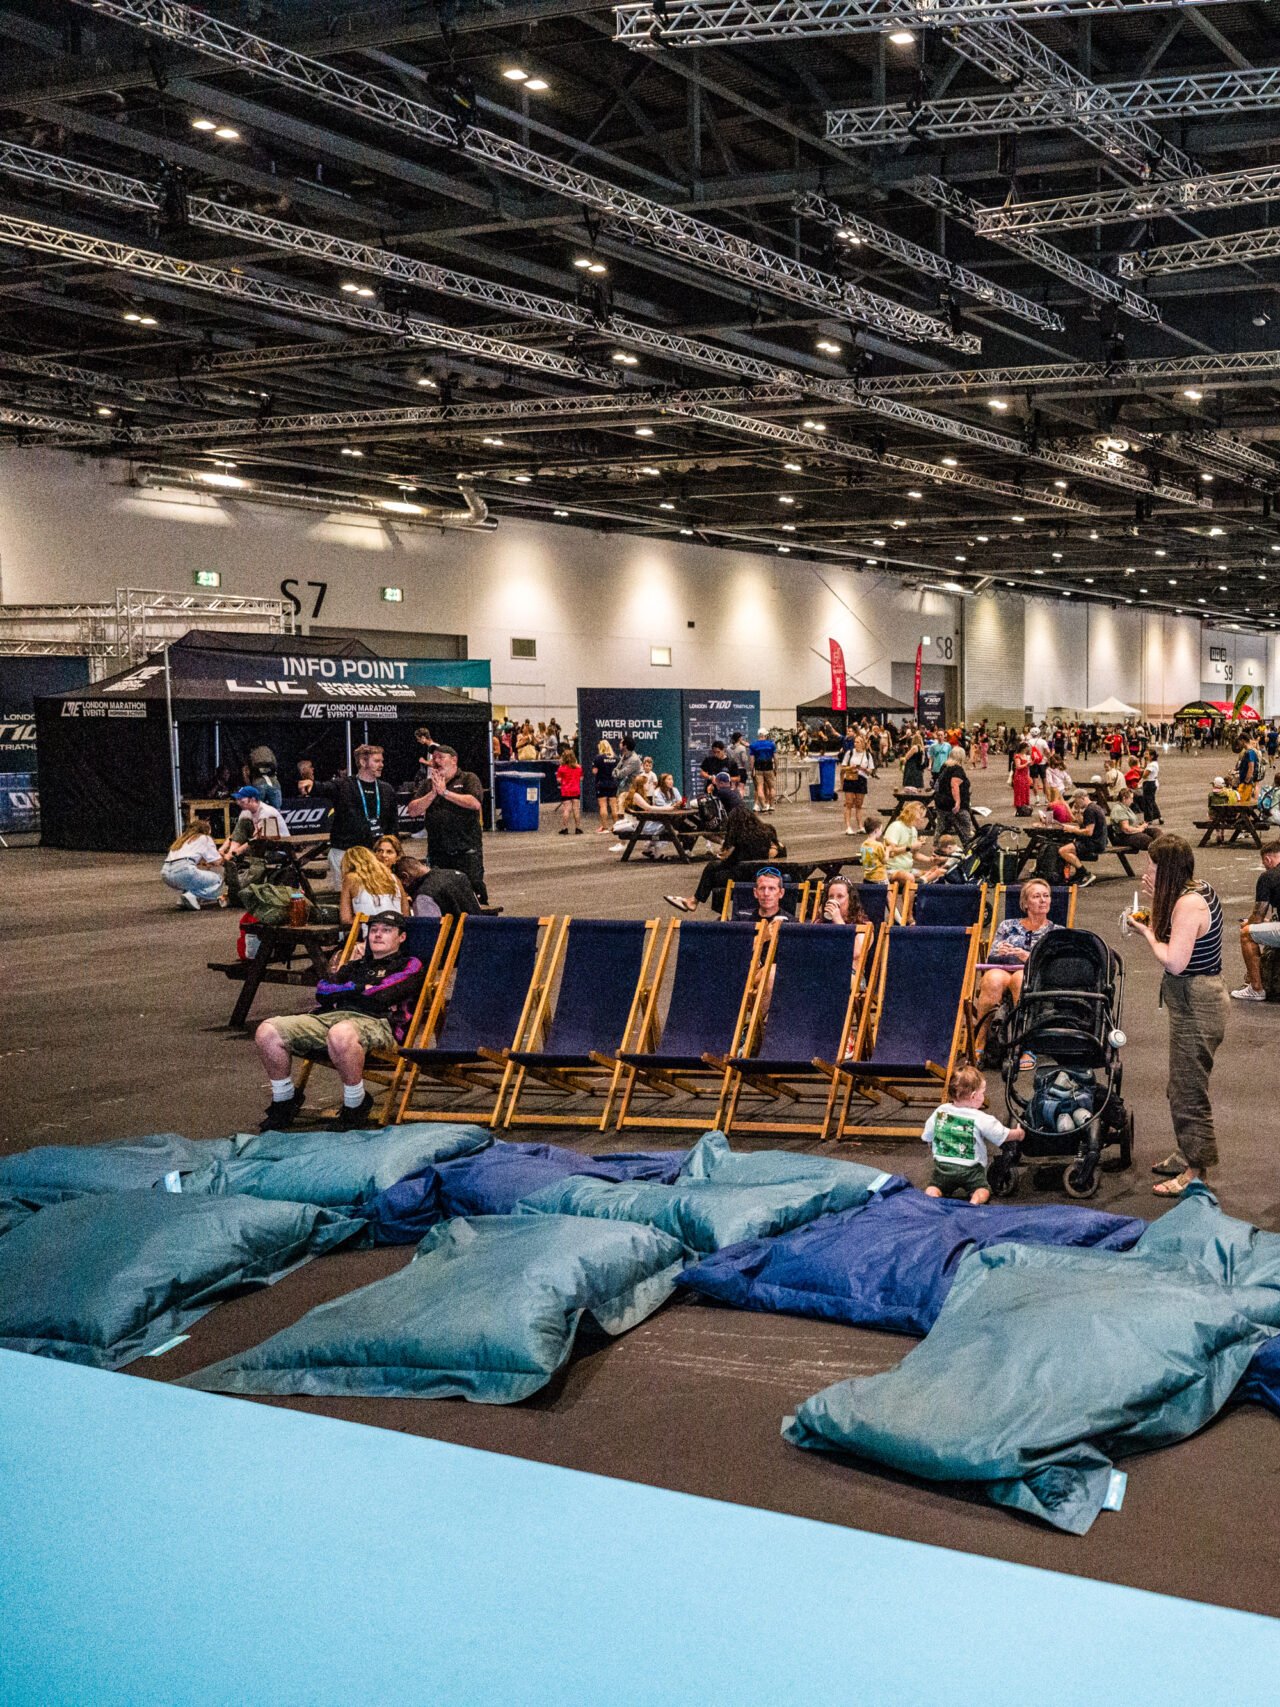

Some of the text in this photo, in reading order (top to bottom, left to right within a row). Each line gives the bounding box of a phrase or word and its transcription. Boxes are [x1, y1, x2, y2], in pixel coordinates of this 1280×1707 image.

[280, 578, 328, 618] S7
[936, 636, 953, 660] S8
[282, 657, 408, 680] INFO POINT
[1225, 665, 1233, 681] S9
[109, 702, 147, 710] MARATHON
[358, 704, 398, 712] MARATHON
[707, 700, 732, 709] T100
[4, 713, 36, 721] LONDO
[83, 709, 105, 717] EVENTS
[595, 719, 663, 728] WATER BOTTLE
[0, 723, 37, 741] T10
[632, 731, 659, 740] POINT
[0, 743, 38, 751] TRIATHL
[280, 808, 326, 824] 100
